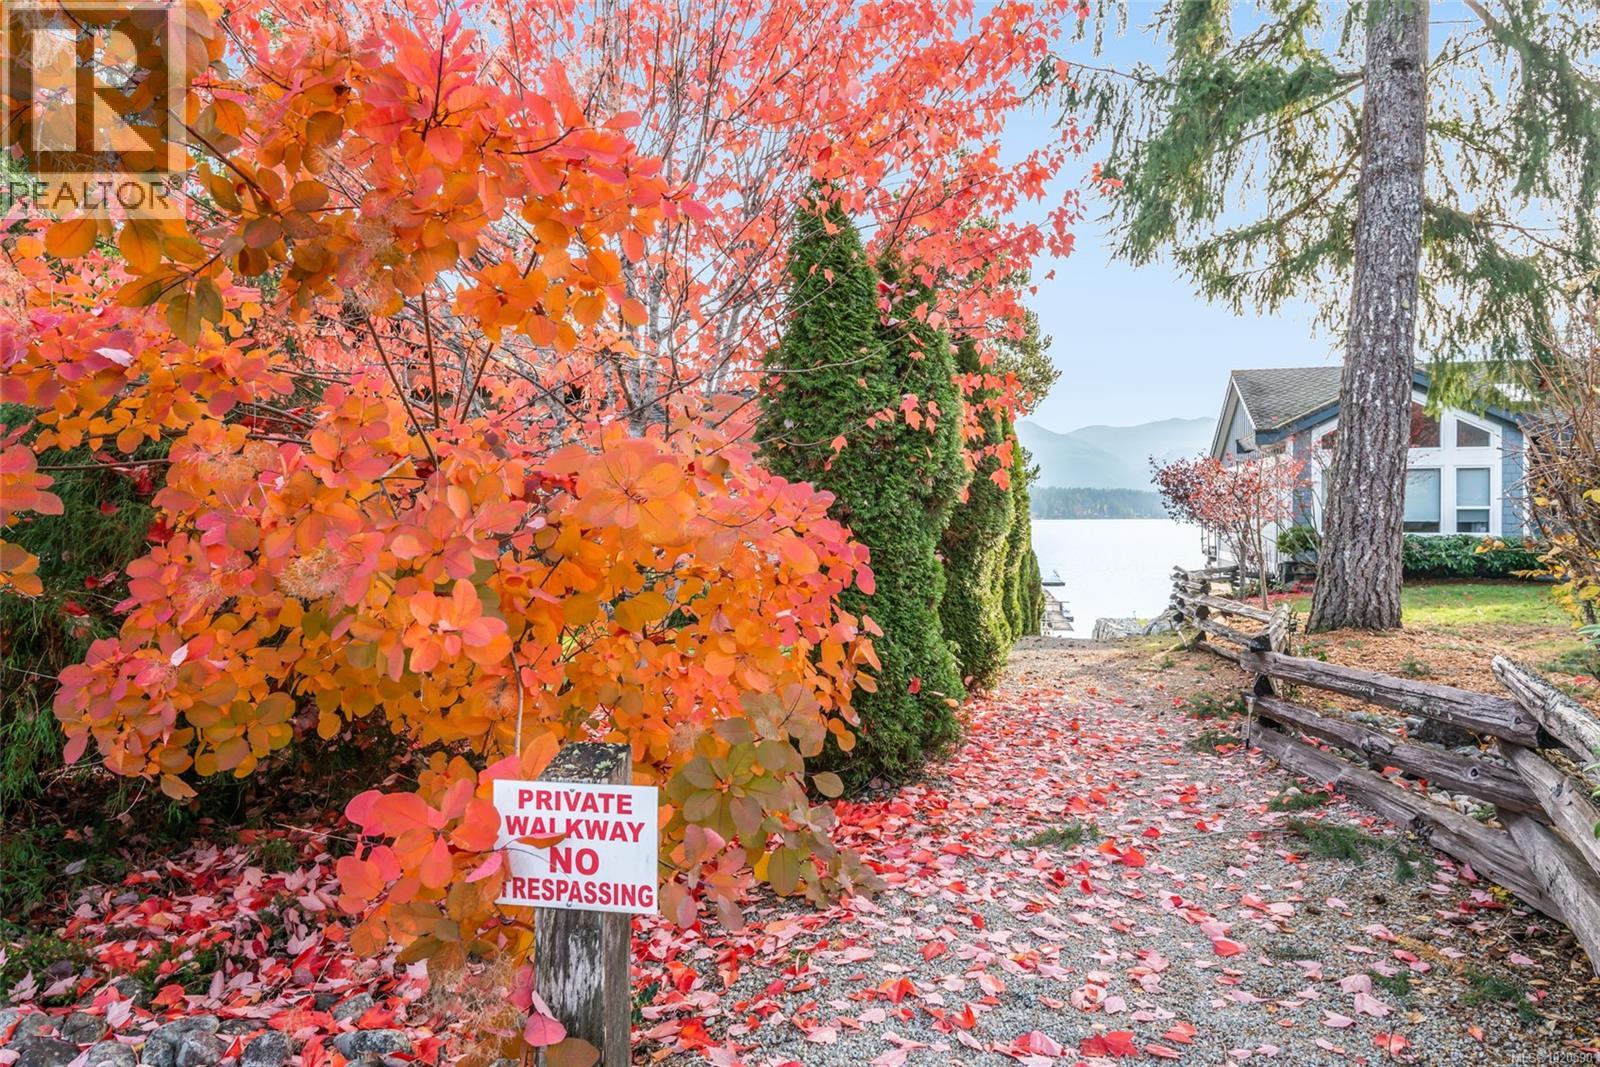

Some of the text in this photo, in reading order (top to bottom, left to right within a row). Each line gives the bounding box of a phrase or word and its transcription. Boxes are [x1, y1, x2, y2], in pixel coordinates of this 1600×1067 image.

[518, 789, 633, 815] PRIVATE
[505, 815, 645, 843] WALKWAY
[549, 847, 600, 876] NO
[501, 876, 654, 908] TRESPASSING
